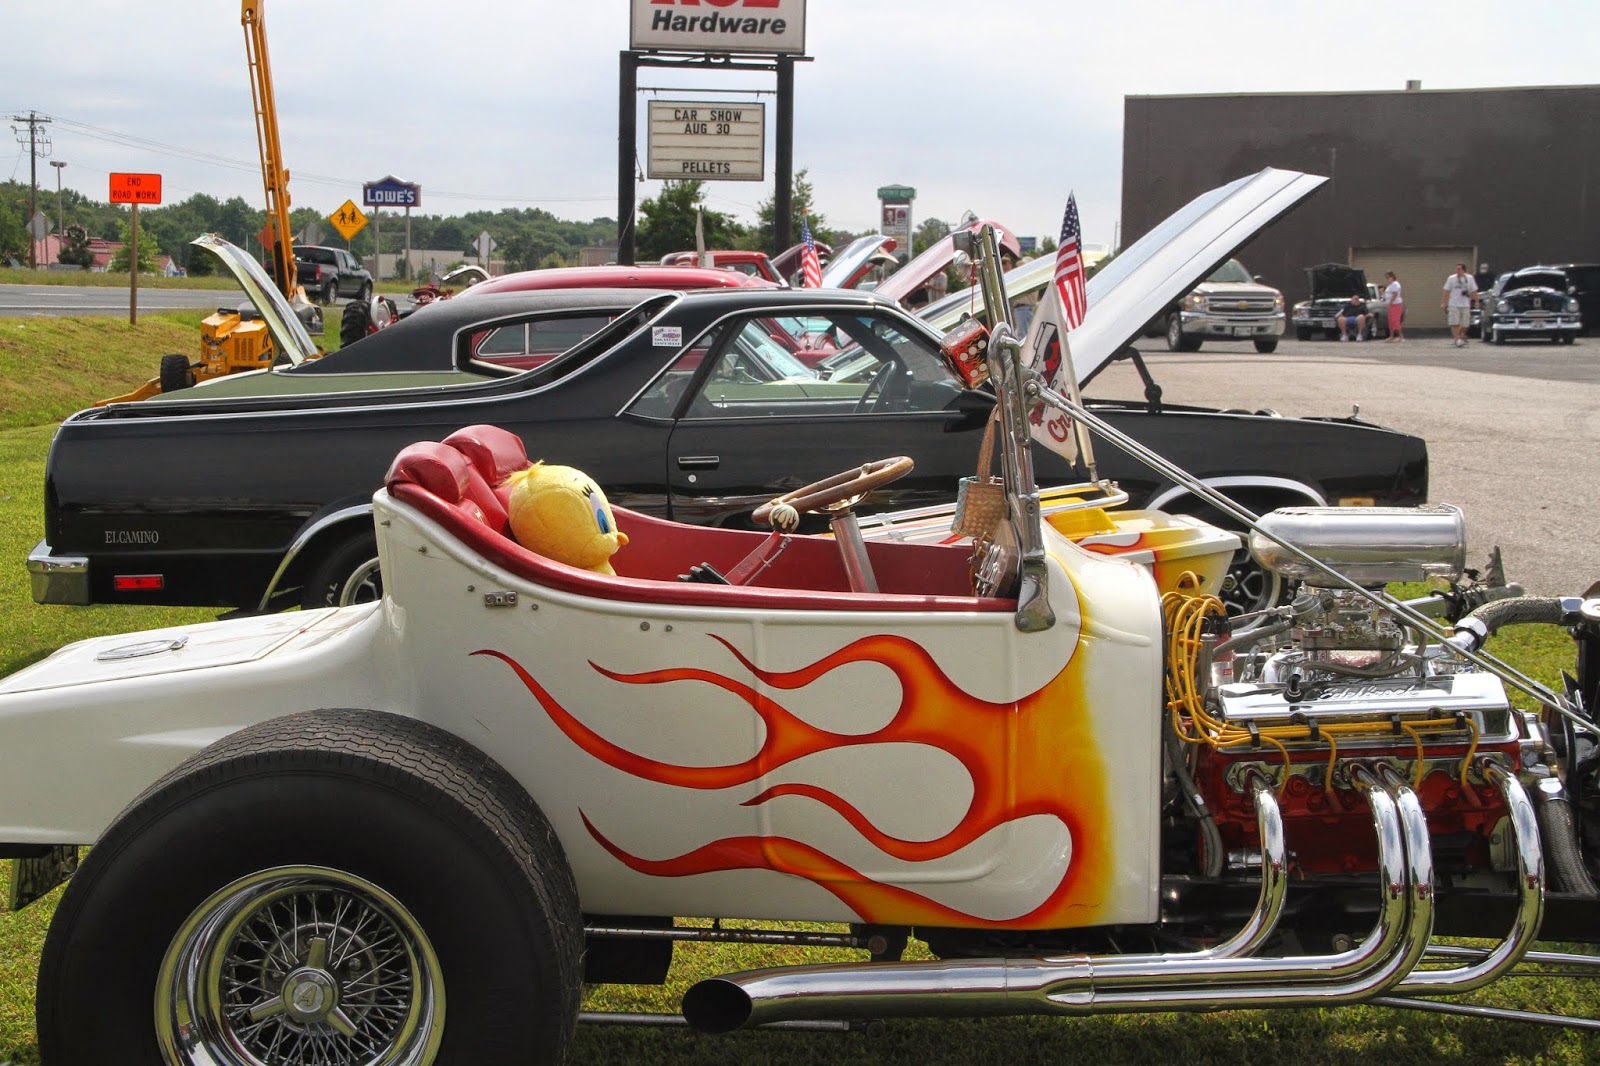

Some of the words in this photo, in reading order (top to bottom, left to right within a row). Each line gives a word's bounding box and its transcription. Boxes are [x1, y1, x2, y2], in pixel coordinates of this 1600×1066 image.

[651, 9, 787, 35] Hardware
[674, 109, 698, 121] CAR
[710, 110, 742, 122] SHOW
[684, 123, 708, 134] AUG
[716, 123, 731, 135] 30
[682, 162, 731, 174] PELLETS
[127, 177, 142, 187] END
[112, 189, 132, 199] ROAD
[135, 190, 157, 200] WORK
[366, 188, 415, 204] LOWE'S
